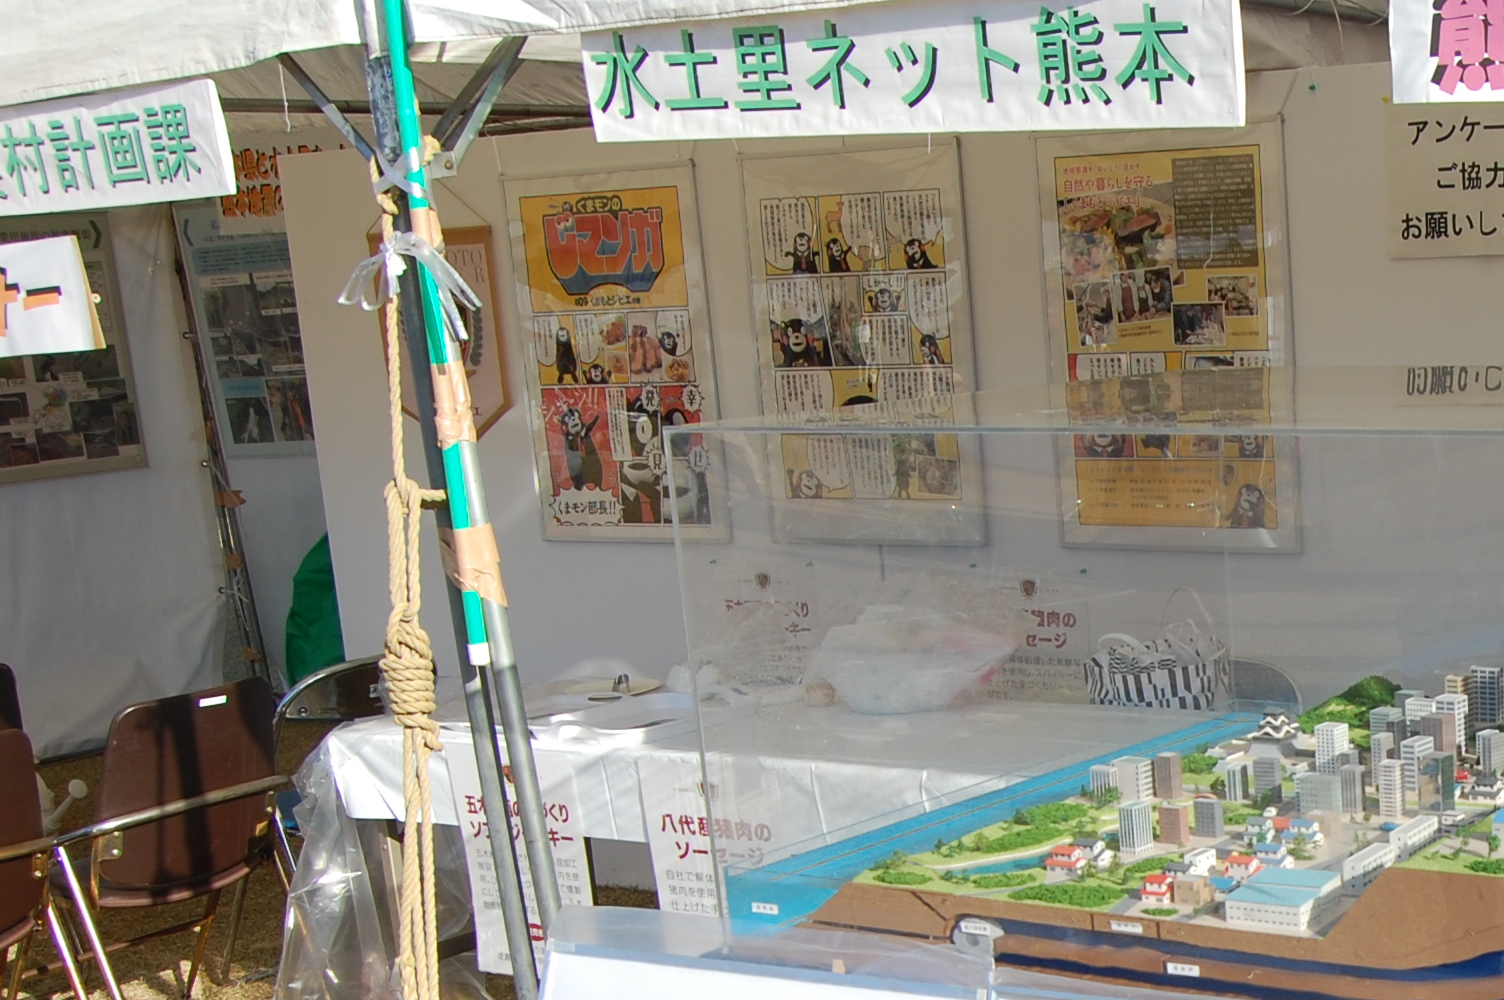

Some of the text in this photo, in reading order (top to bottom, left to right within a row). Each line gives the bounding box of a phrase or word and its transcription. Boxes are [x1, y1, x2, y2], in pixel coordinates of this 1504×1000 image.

[590, 4, 1196, 118] 水土里ネット熊本
[0, 103, 201, 199] 村計画課
[1063, 175, 1153, 193] 自然や暮らしを守る
